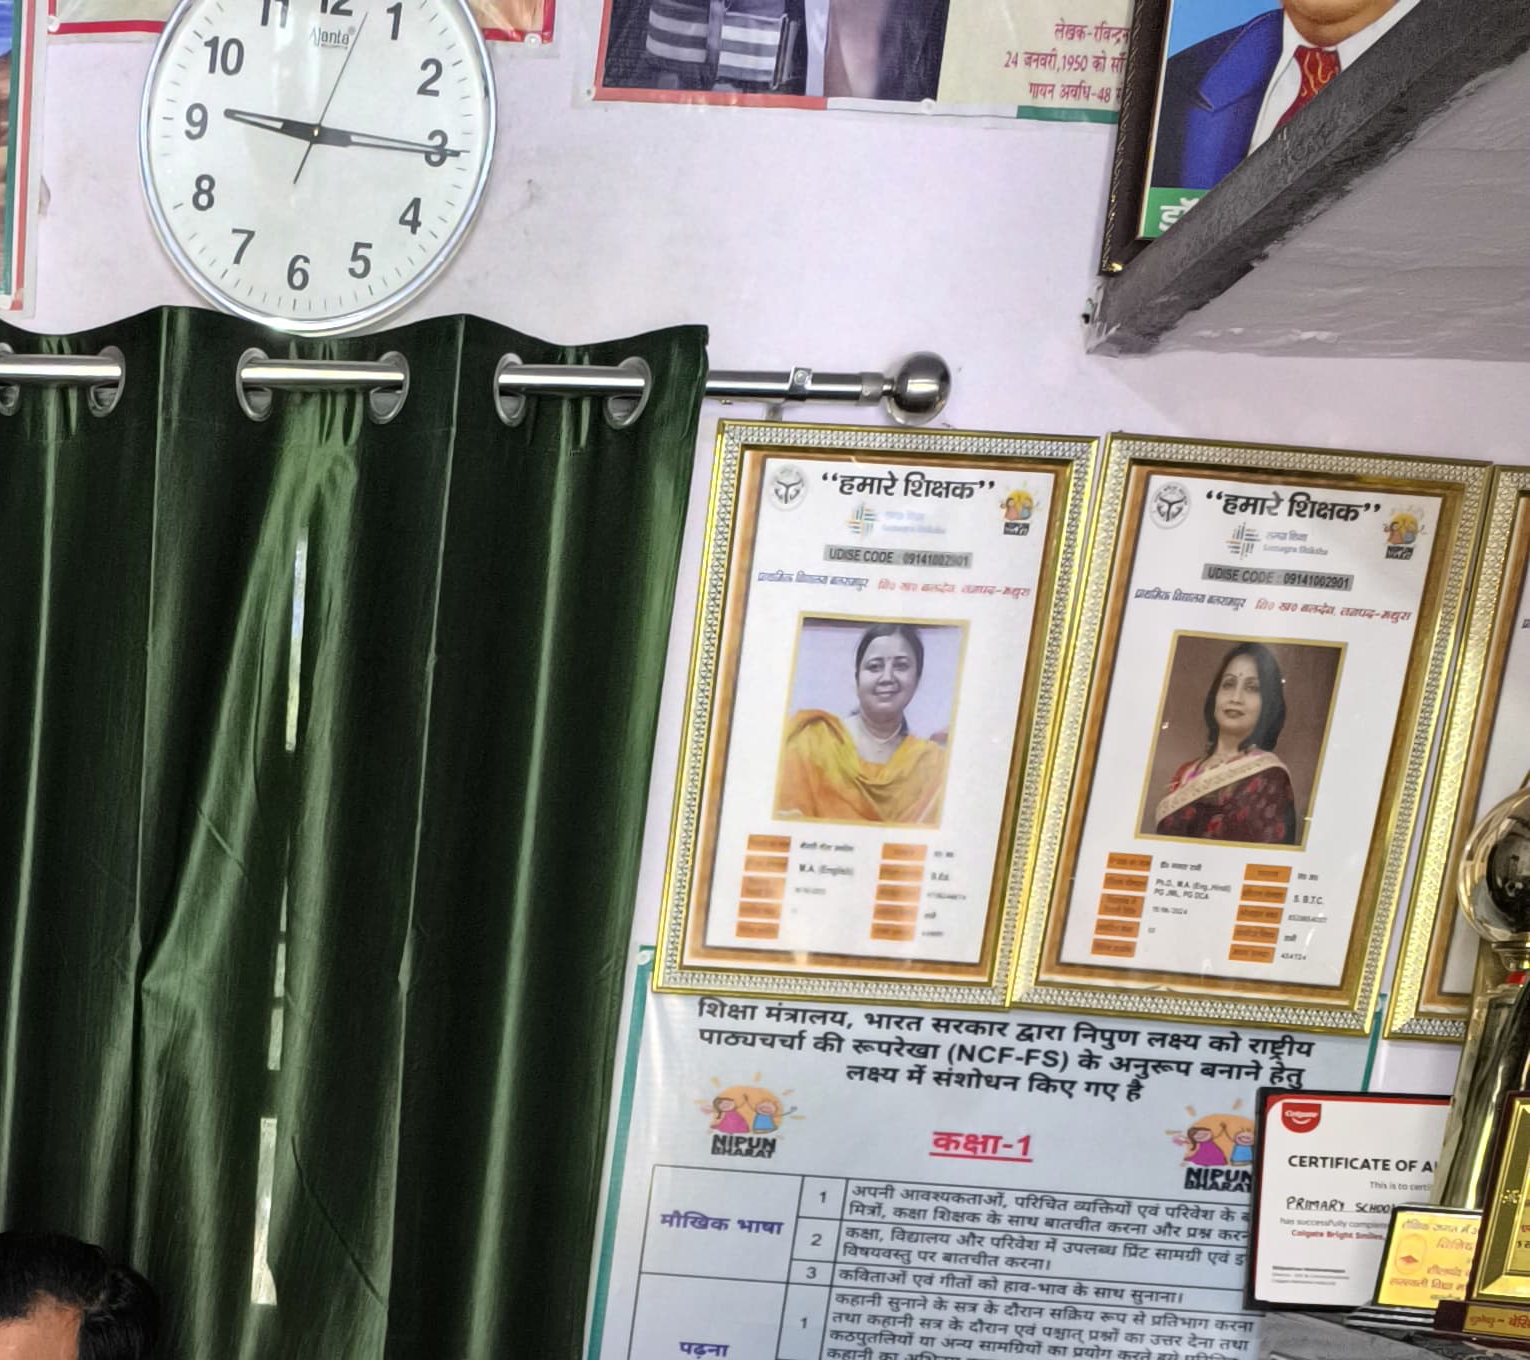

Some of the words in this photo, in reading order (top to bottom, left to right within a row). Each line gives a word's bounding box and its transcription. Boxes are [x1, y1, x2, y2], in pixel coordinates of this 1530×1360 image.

[203, 35, 245, 76] 10
[1004, 51, 1019, 68] 24
[1092, 50, 1107, 73] को
[416, 58, 443, 97] 2
[1029, 82, 1056, 99] गायन
[184, 103, 208, 140] 9
[192, 174, 216, 211] 8
[398, 197, 422, 235] 4
[230, 228, 256, 265] 7
[347, 242, 374, 279] 5
[286, 254, 311, 291] 6
[697, 996, 758, 1022] शिक्षा
[765, 1001, 854, 1031] मंत्रालय,
[863, 1012, 922, 1033] भारत
[930, 1015, 1010, 1039] सरकार
[1015, 1021, 1065, 1045] द्वारा
[1072, 1021, 1141, 1051] निपुण
[1146, 1030, 1203, 1053] लक्ष्य
[1208, 1031, 1244, 1054] को
[1247, 1035, 1316, 1062] राष्ट्रीय
[948, 1041, 1070, 1074] (NCF-FS)
[1077, 1049, 1104, 1072] के
[1108, 1055, 1195, 1081] अनुरूप
[1288, 1154, 1391, 1172] CERTIFICATE
[1395, 1159, 1419, 1172] OF
[1286, 1196, 1346, 1213] PRIMARY
[737, 1218, 785, 1236] भाषा
